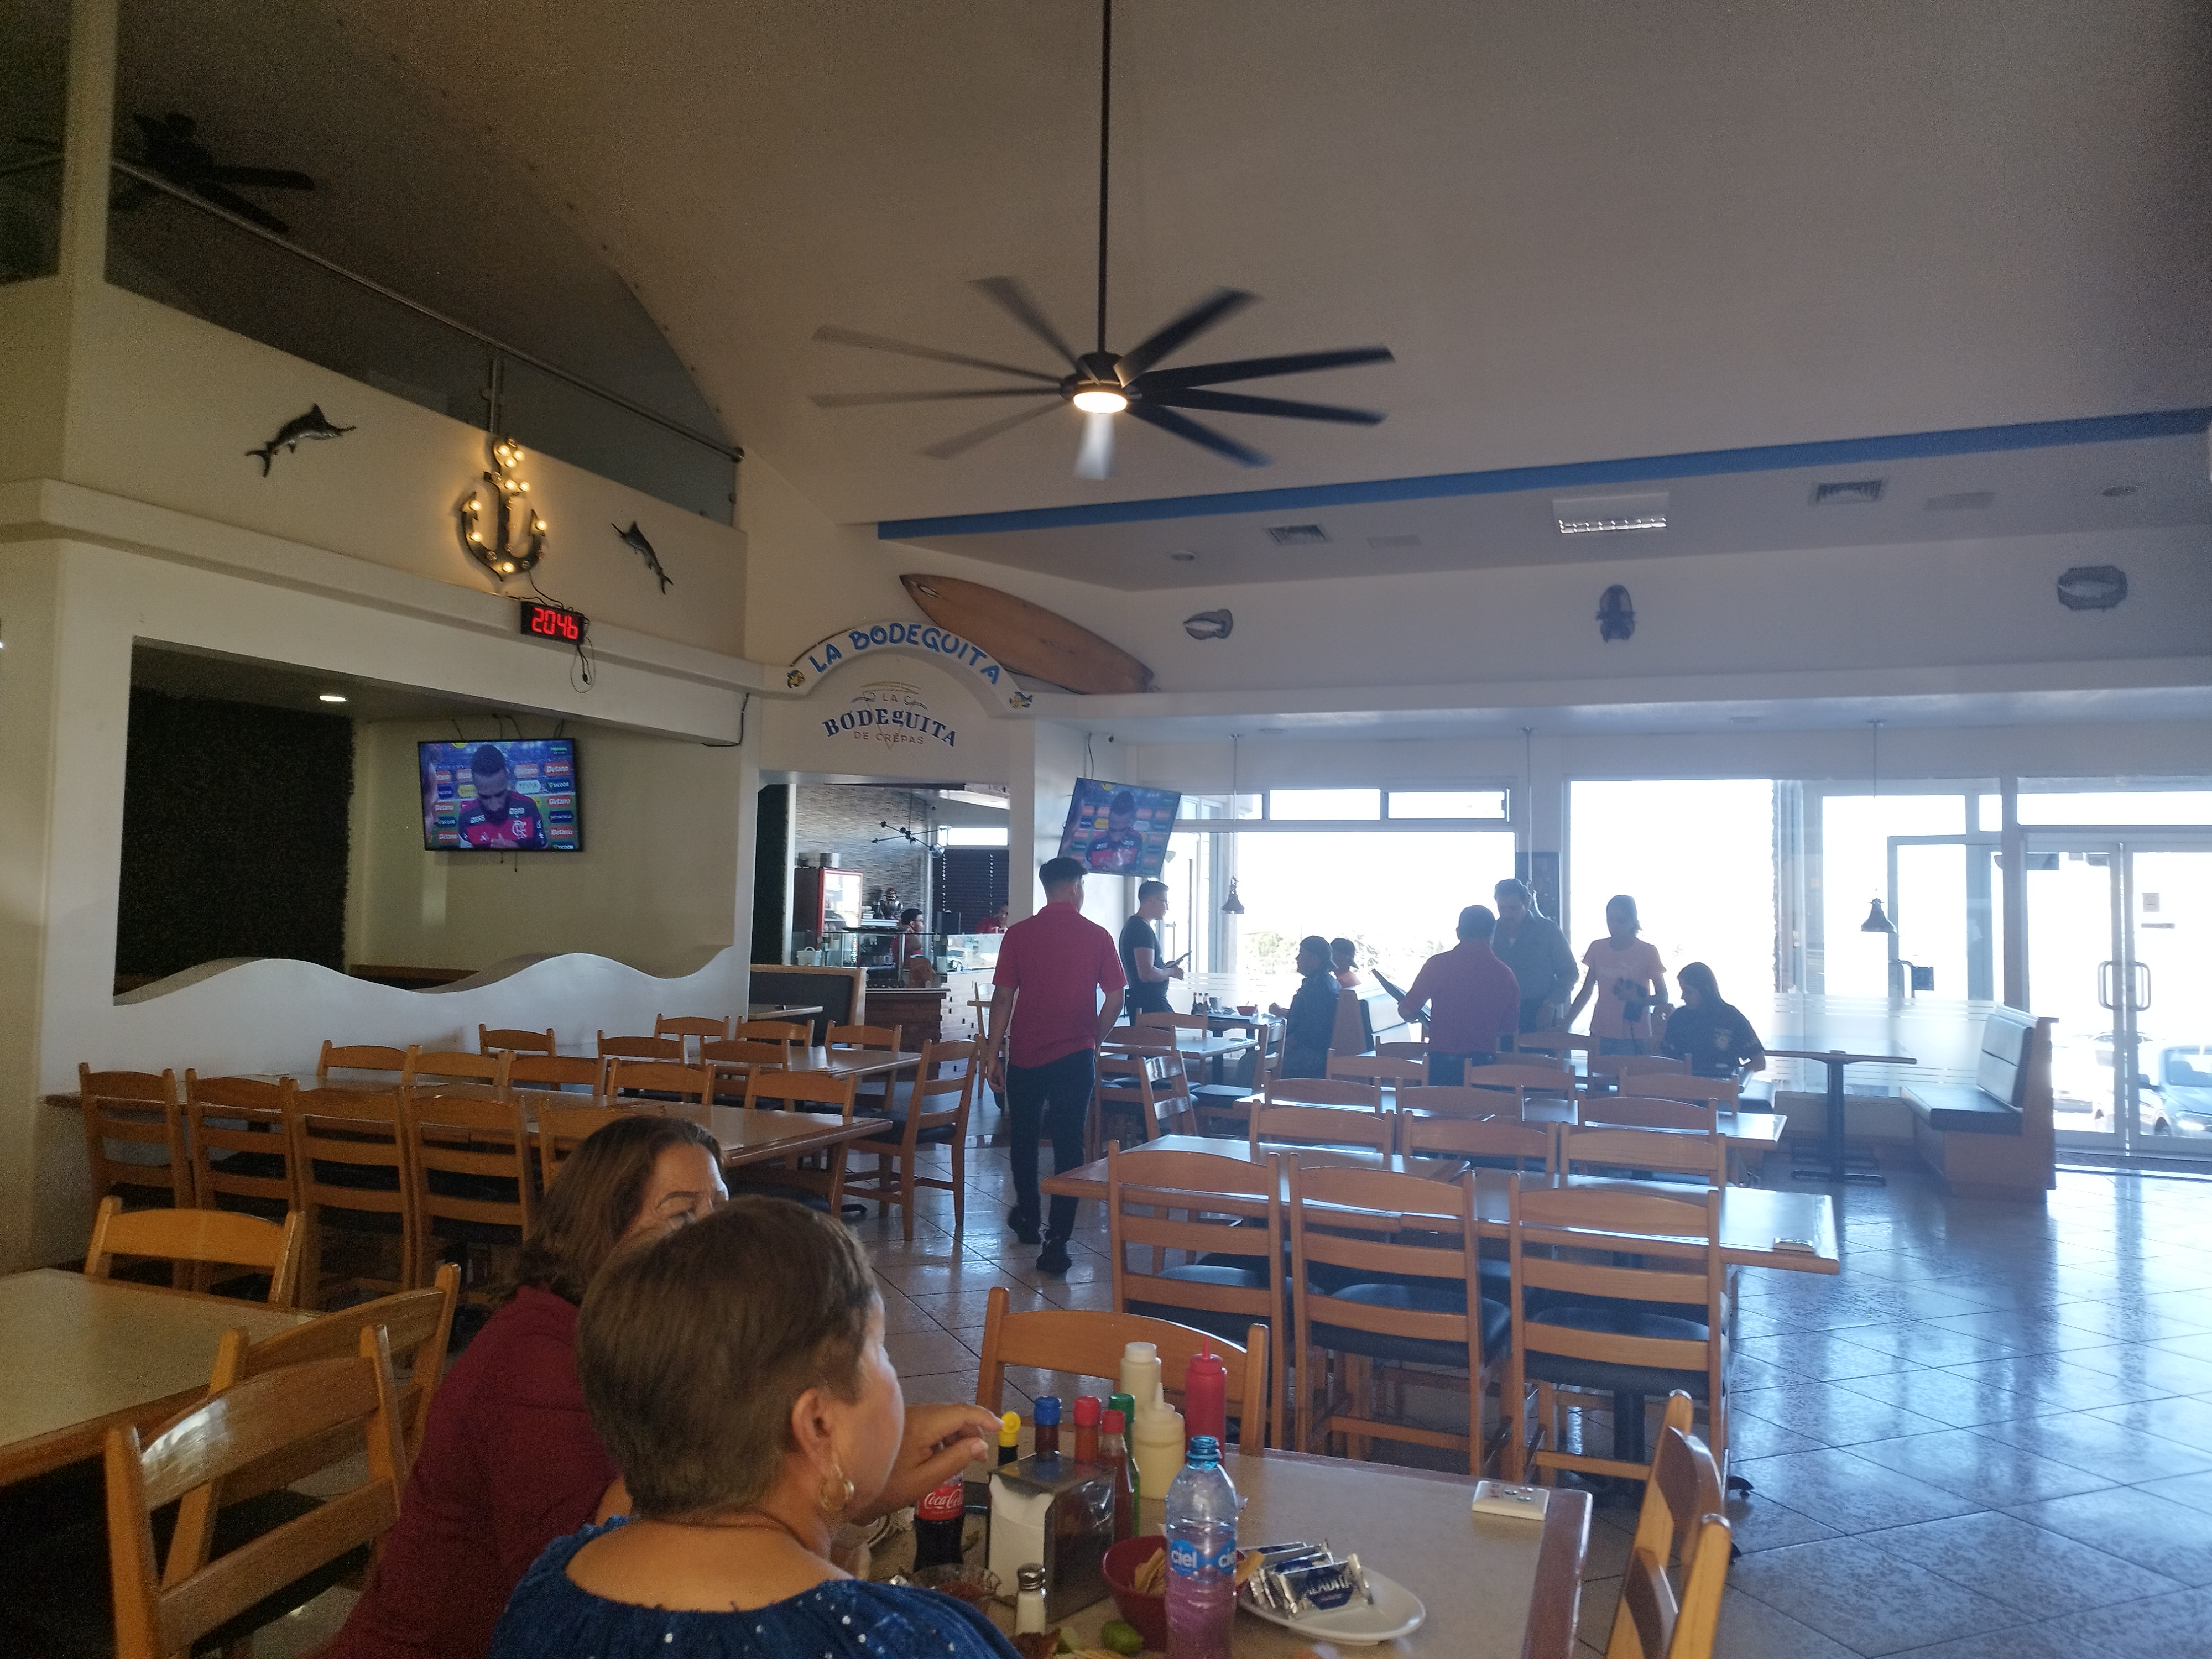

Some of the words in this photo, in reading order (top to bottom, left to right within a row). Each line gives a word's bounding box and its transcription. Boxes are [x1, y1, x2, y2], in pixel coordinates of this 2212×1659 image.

[809, 643, 842, 673] LA
[854, 732, 869, 740] DE
[1171, 1547, 1197, 1568] ciel
